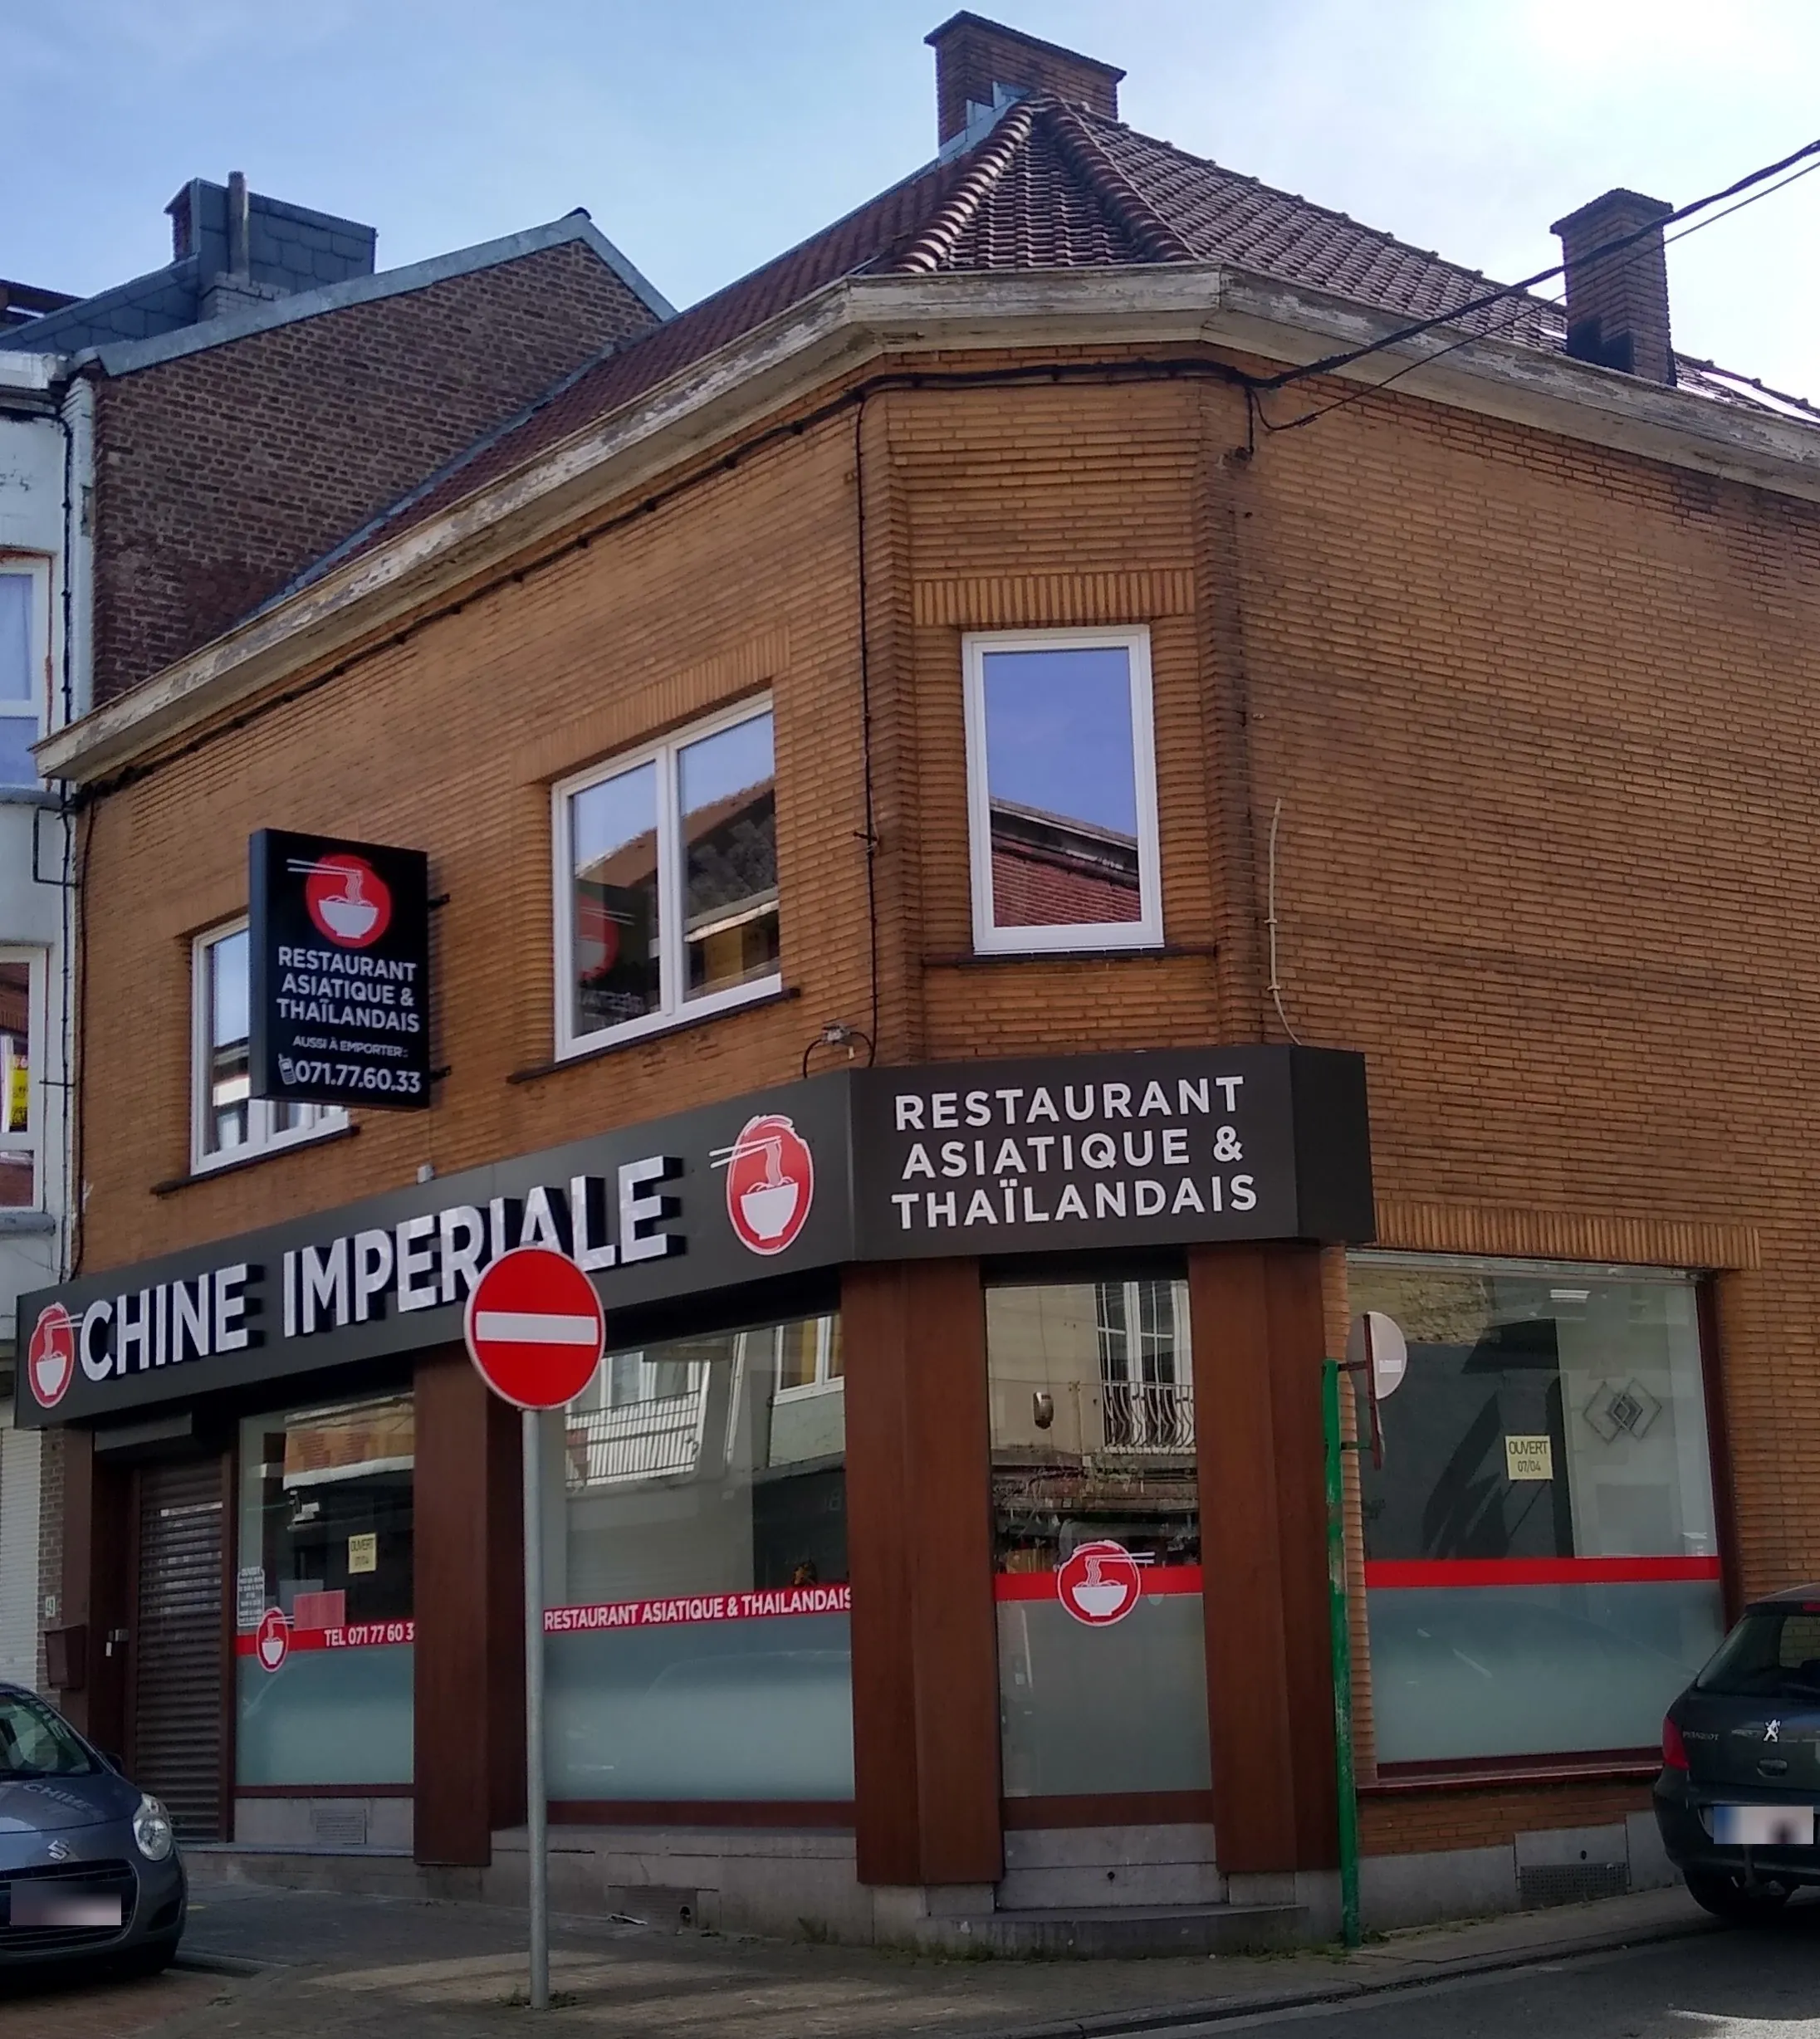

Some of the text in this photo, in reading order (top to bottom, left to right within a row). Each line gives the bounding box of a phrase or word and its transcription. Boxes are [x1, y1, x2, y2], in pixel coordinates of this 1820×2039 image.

[278, 946, 418, 981] RESTAURANT
[281, 973, 414, 1006] ASIATIQUE &
[276, 998, 420, 1033] THAÏLANDAIS
[292, 1035, 327, 1049] AUSSI
[295, 1059, 422, 1093] 071.77.60.33
[895, 1076, 1244, 1131] RESTAURANT
[902, 1126, 1243, 1180] ASIATIQUE &
[891, 1175, 1257, 1230] THAÏLANDAIS
[80, 1154, 668, 1381] CHINE IMPERIALE
[1509, 1440, 1548, 1455] OUVERT
[544, 1604, 638, 1631] RESTAURANT
[641, 1597, 723, 1624] ASIATIQUE
[727, 1597, 738, 1618] &
[324, 1627, 346, 1646] TEL
[348, 1626, 367, 1645] 071
[370, 1624, 384, 1644] 77
[387, 1623, 403, 1642] 60
